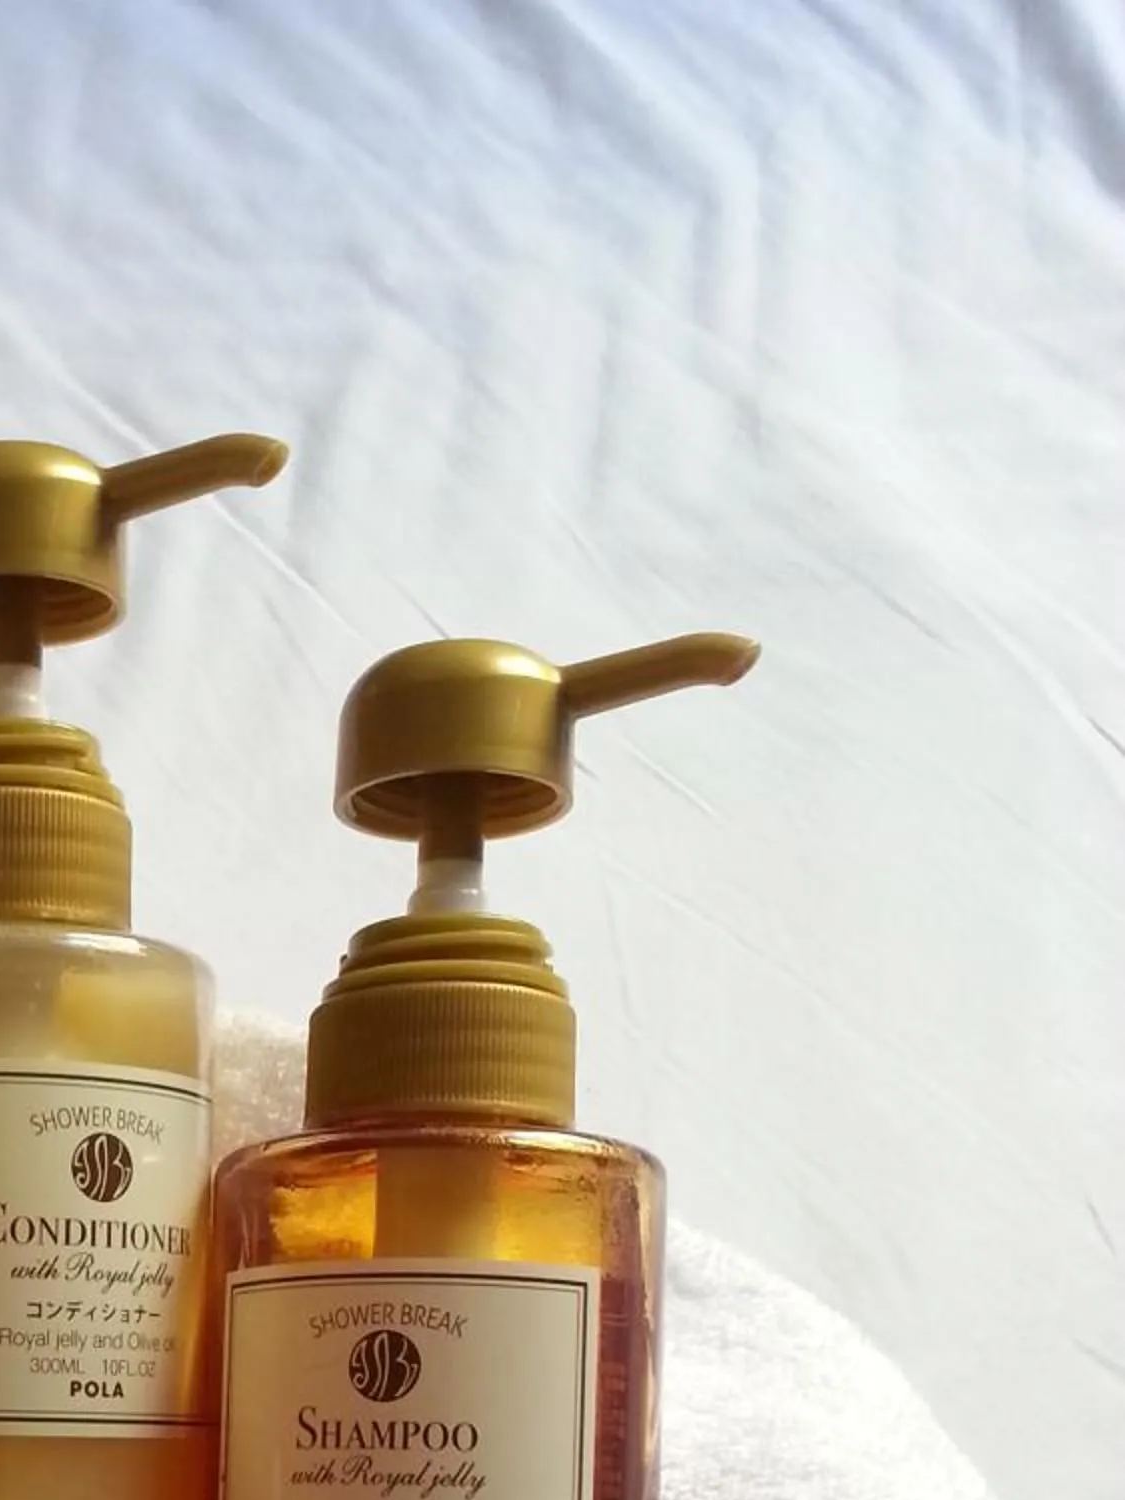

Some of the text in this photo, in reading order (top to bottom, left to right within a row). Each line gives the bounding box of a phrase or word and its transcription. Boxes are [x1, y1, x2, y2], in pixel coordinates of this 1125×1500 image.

[29, 1105, 165, 1146] SHOWER BREAK
[10, 1251, 176, 1299] with Royal jelly
[26, 1300, 162, 1325] コンディショナー
[308, 1303, 469, 1339] SHOWER BREAK
[55, 1331, 88, 1353] jelly
[92, 1332, 124, 1351] and
[70, 1380, 124, 1399] POLA
[295, 1406, 479, 1452] SHAMPOO
[288, 1454, 487, 1500] with Royal jelly
